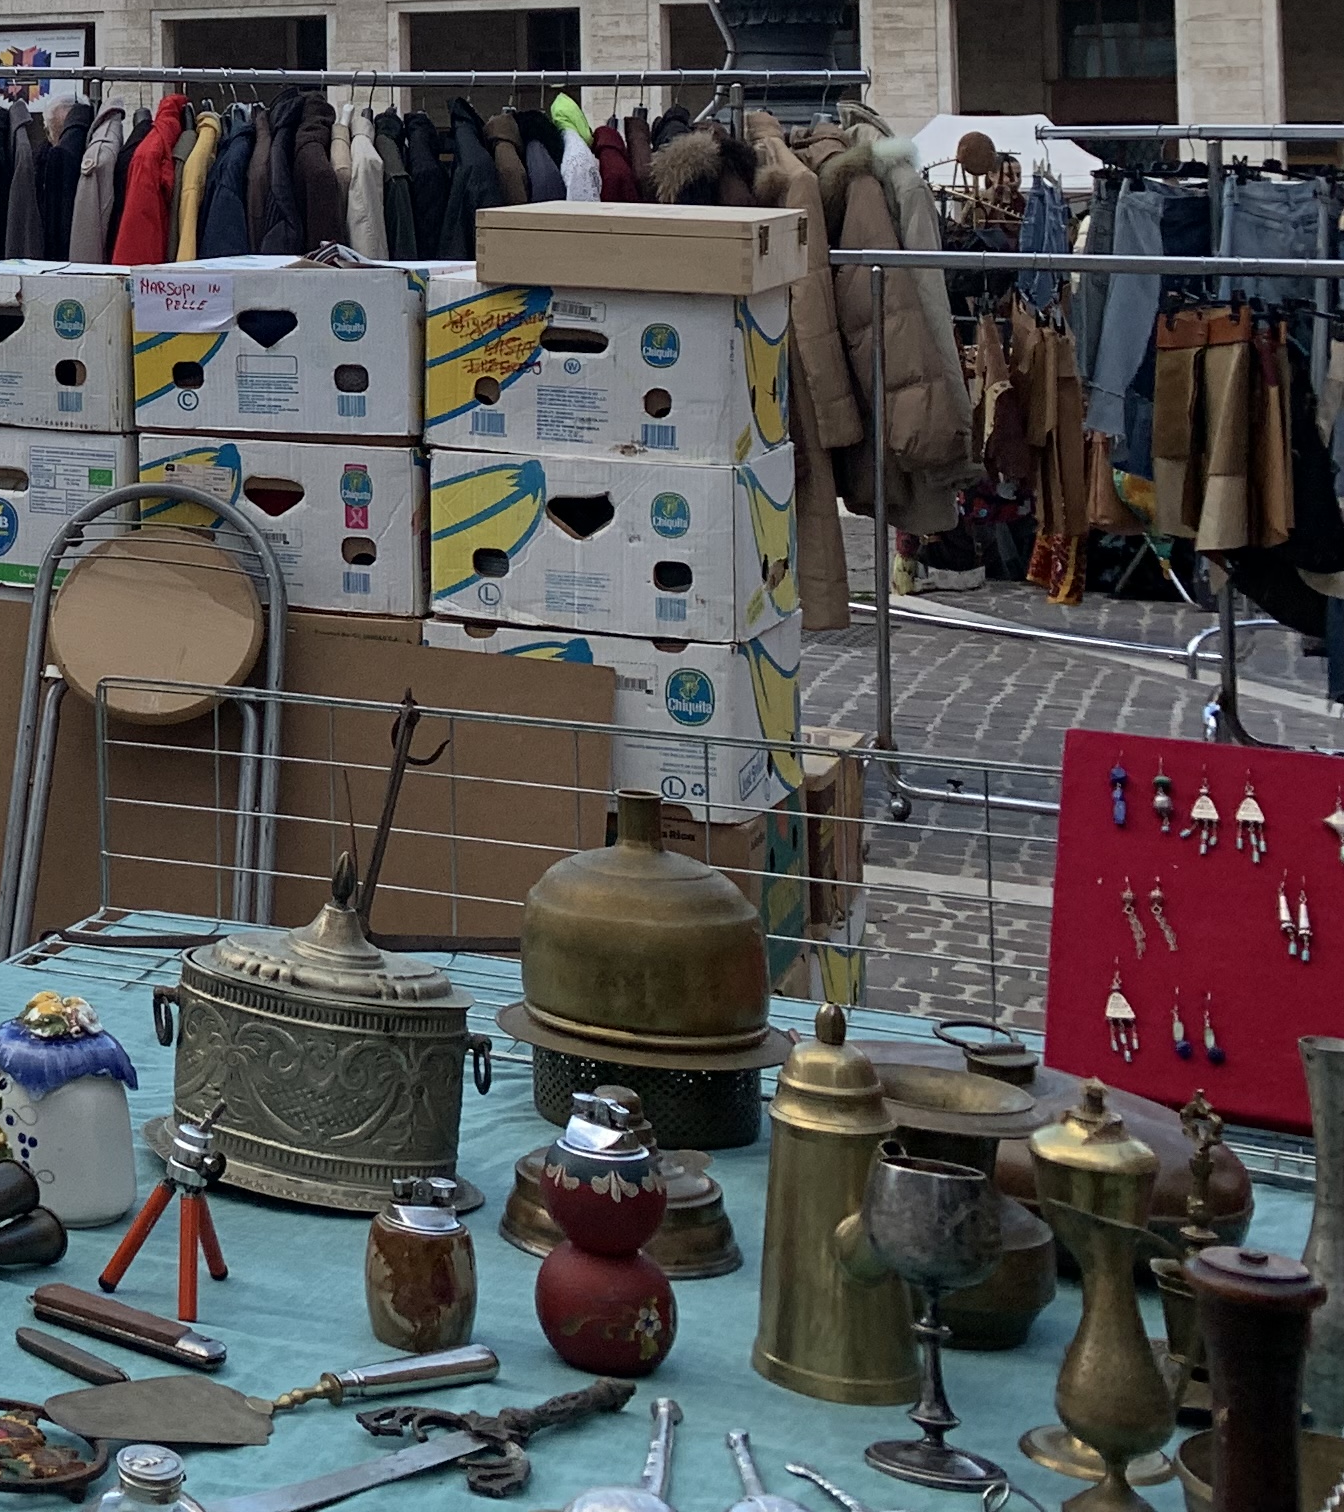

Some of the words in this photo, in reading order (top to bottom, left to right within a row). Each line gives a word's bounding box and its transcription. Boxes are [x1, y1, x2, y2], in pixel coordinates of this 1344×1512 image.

[165, 297, 208, 311] PELLE
[643, 346, 678, 361] Chiquita
[653, 515, 689, 530] Chiquita
[668, 697, 713, 716] Chiquita
